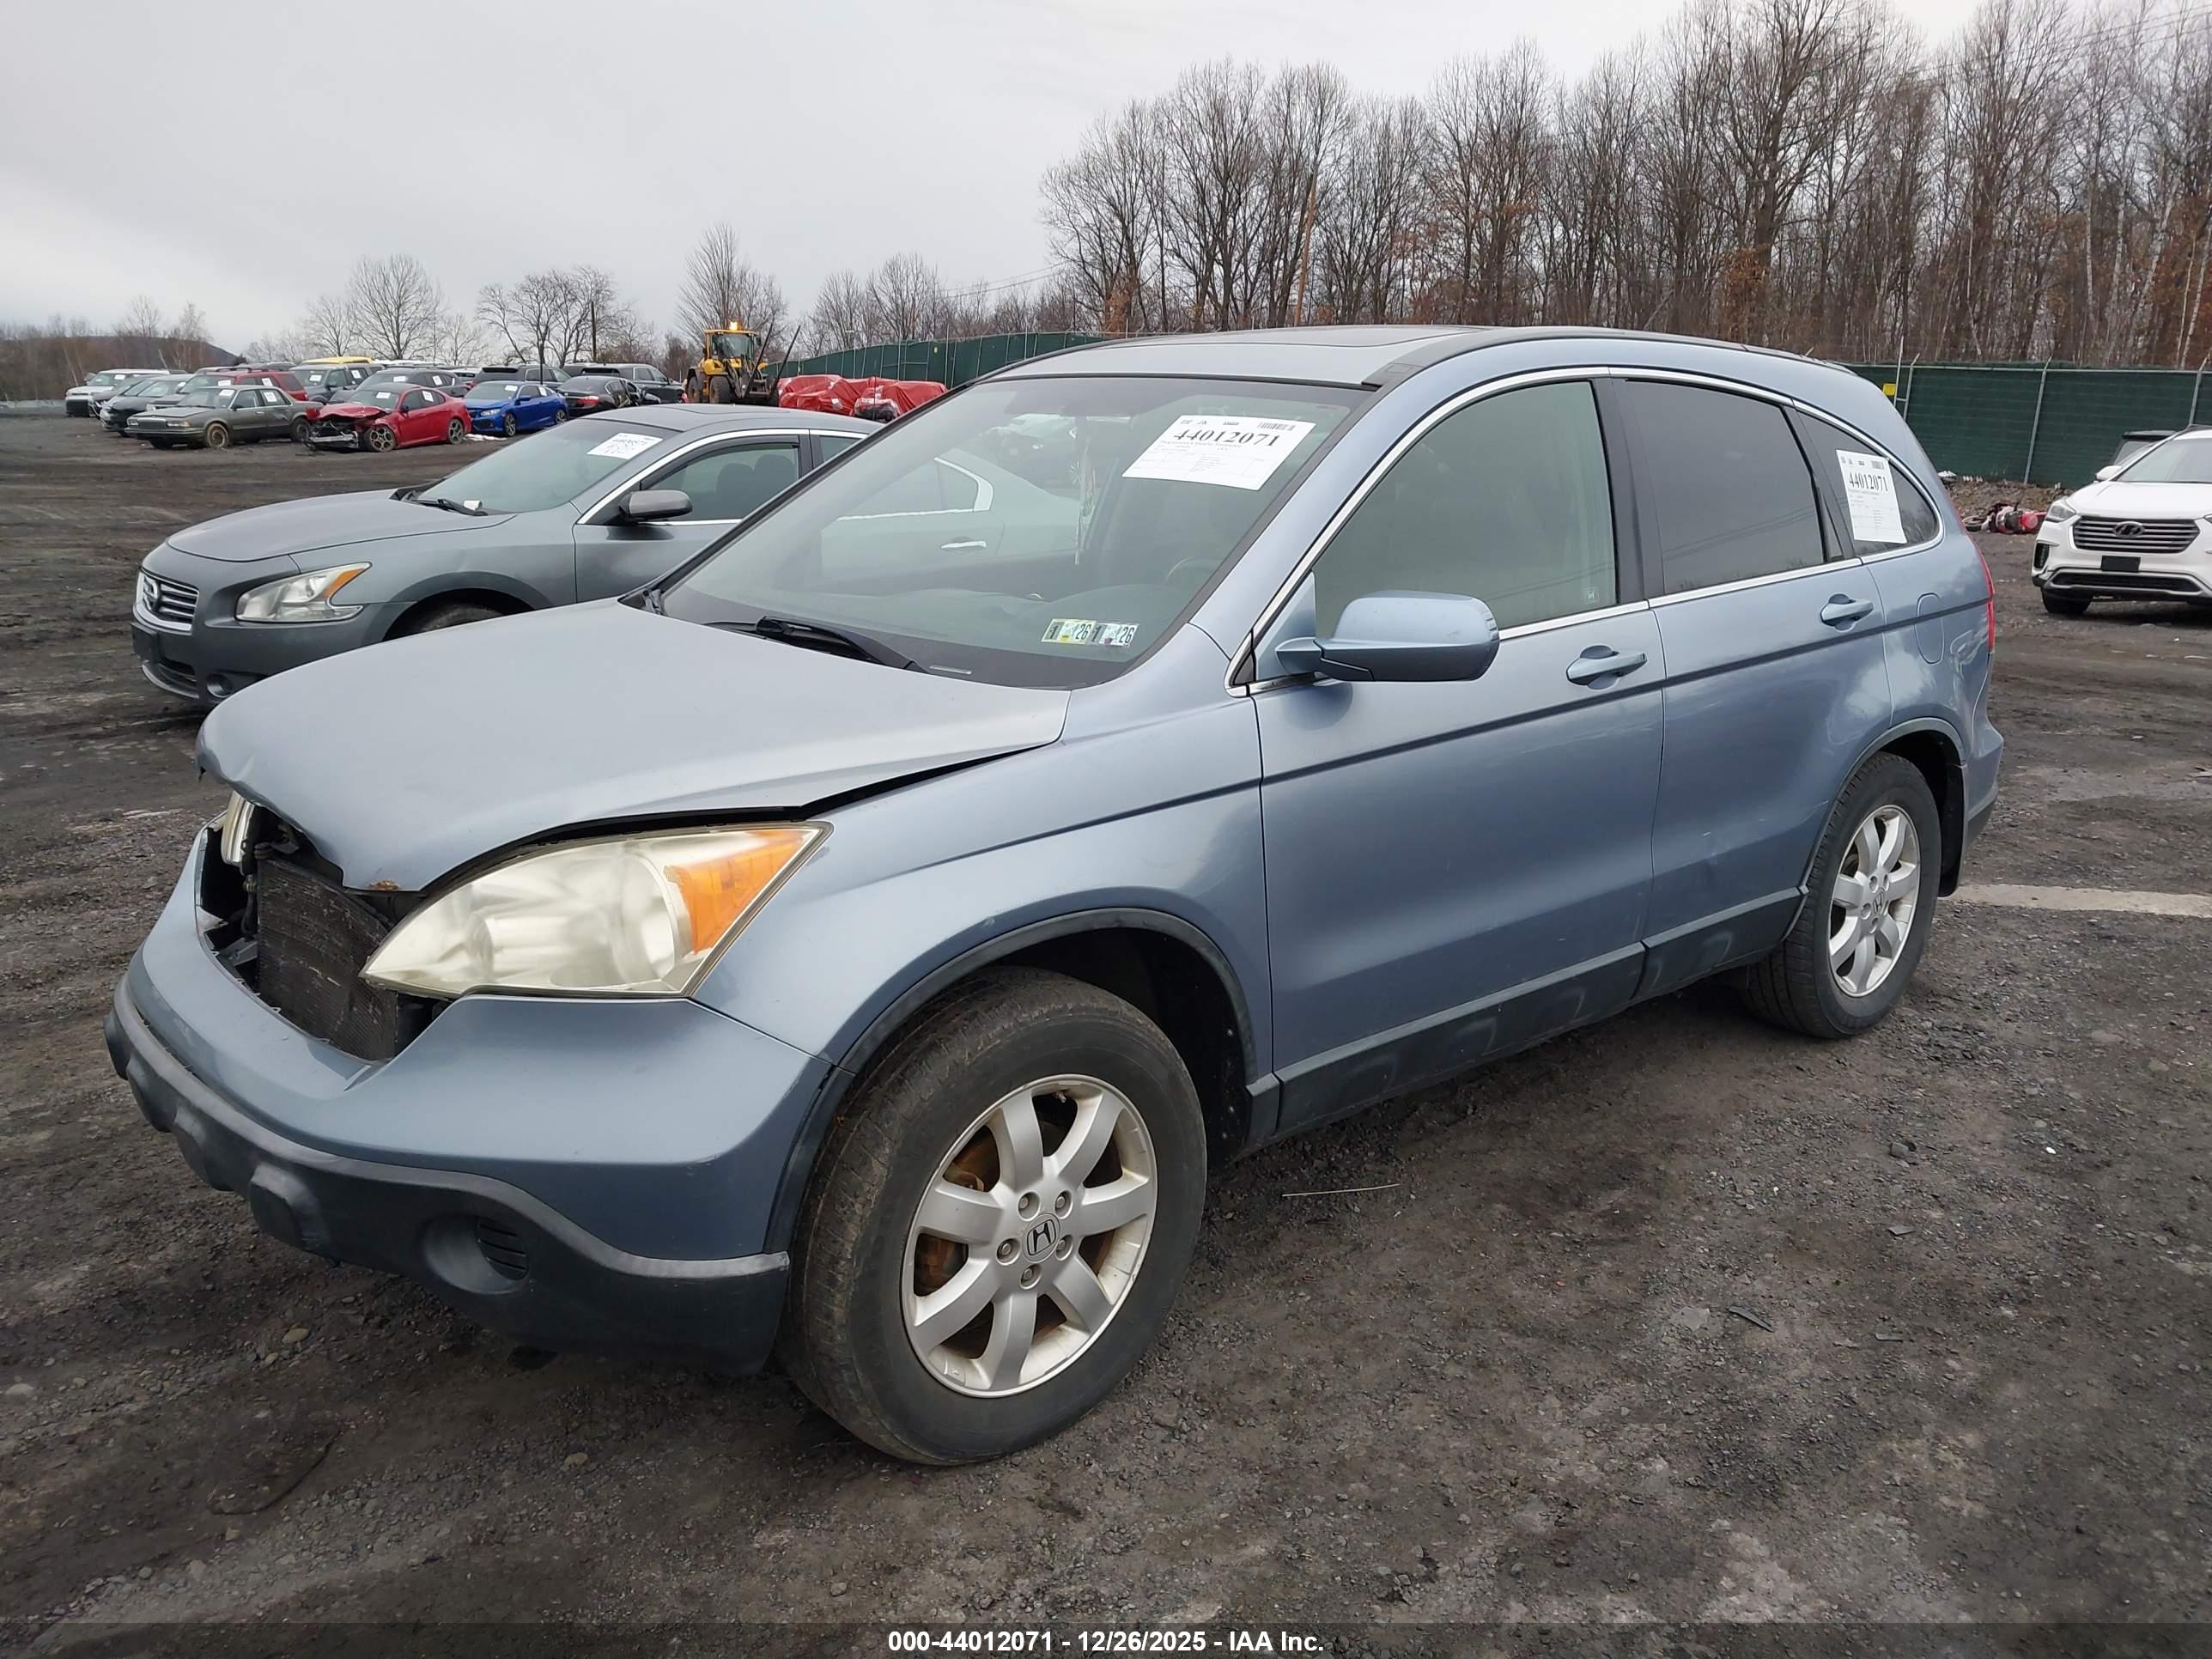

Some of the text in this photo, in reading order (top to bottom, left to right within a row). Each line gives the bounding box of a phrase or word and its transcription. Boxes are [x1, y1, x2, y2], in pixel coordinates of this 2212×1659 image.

[1174, 428, 1280, 447] 44012071
[1849, 471, 1889, 492] 44012071
[1118, 626, 1136, 644] 26
